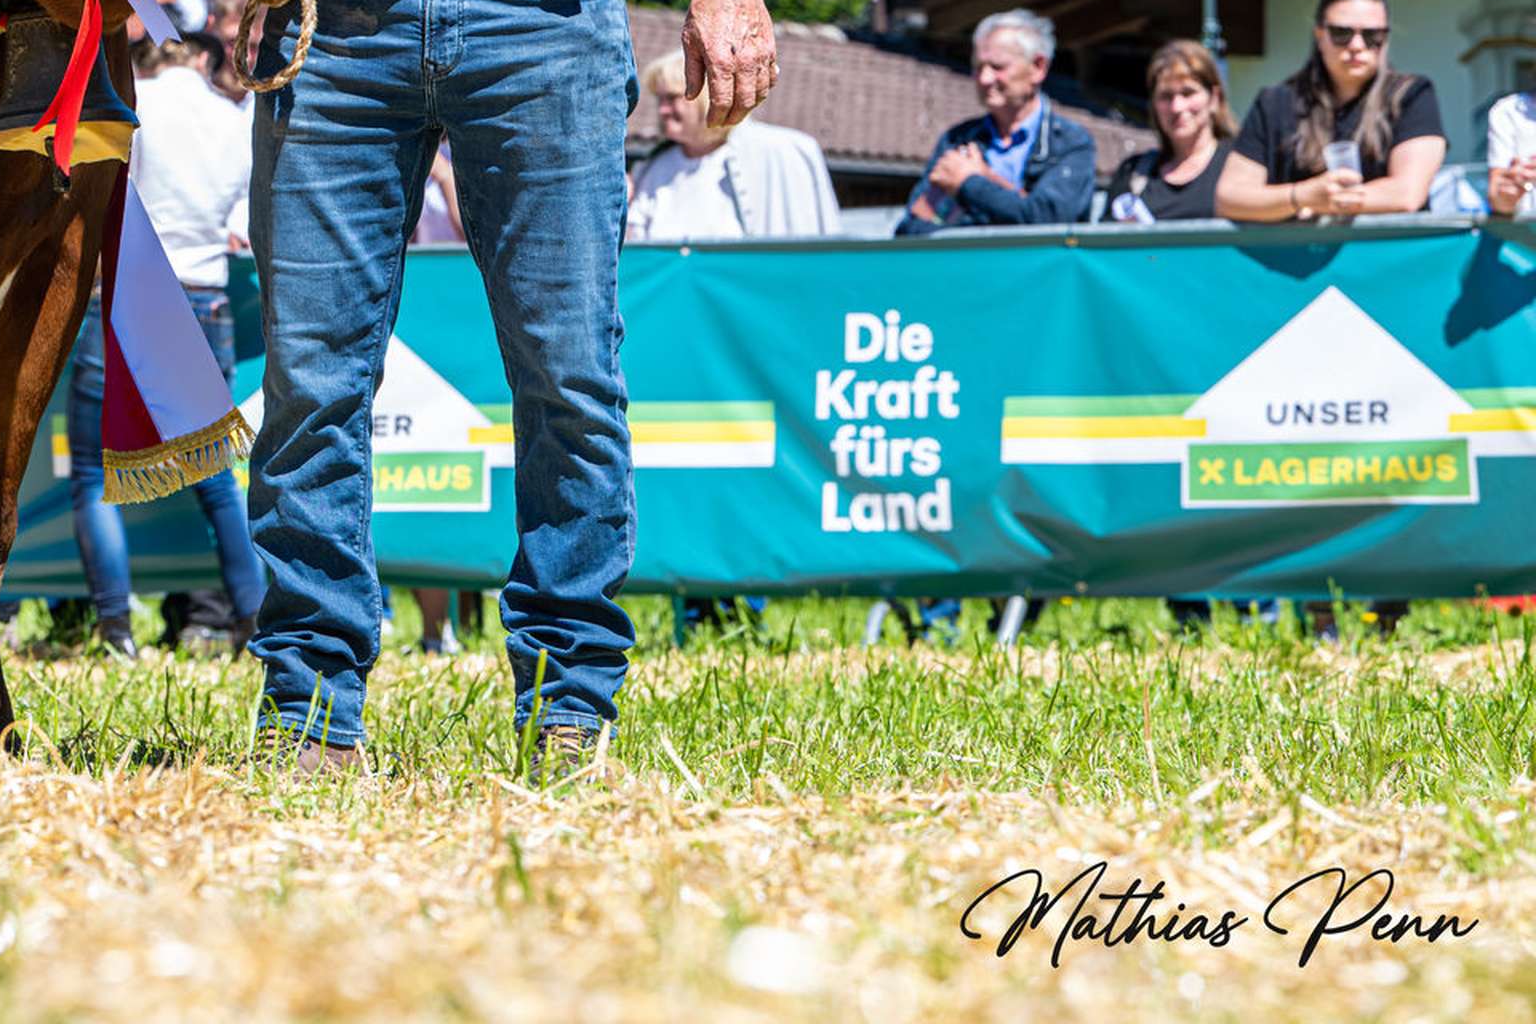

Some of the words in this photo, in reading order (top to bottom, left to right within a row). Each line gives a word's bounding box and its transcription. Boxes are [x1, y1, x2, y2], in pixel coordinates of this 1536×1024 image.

[844, 308, 934, 363] Die
[815, 365, 960, 420] Kraft
[1265, 400, 1390, 426] UNSER
[829, 424, 942, 477] fürs
[1233, 453, 1458, 486] LAGERHAUS
[821, 478, 953, 532] Land
